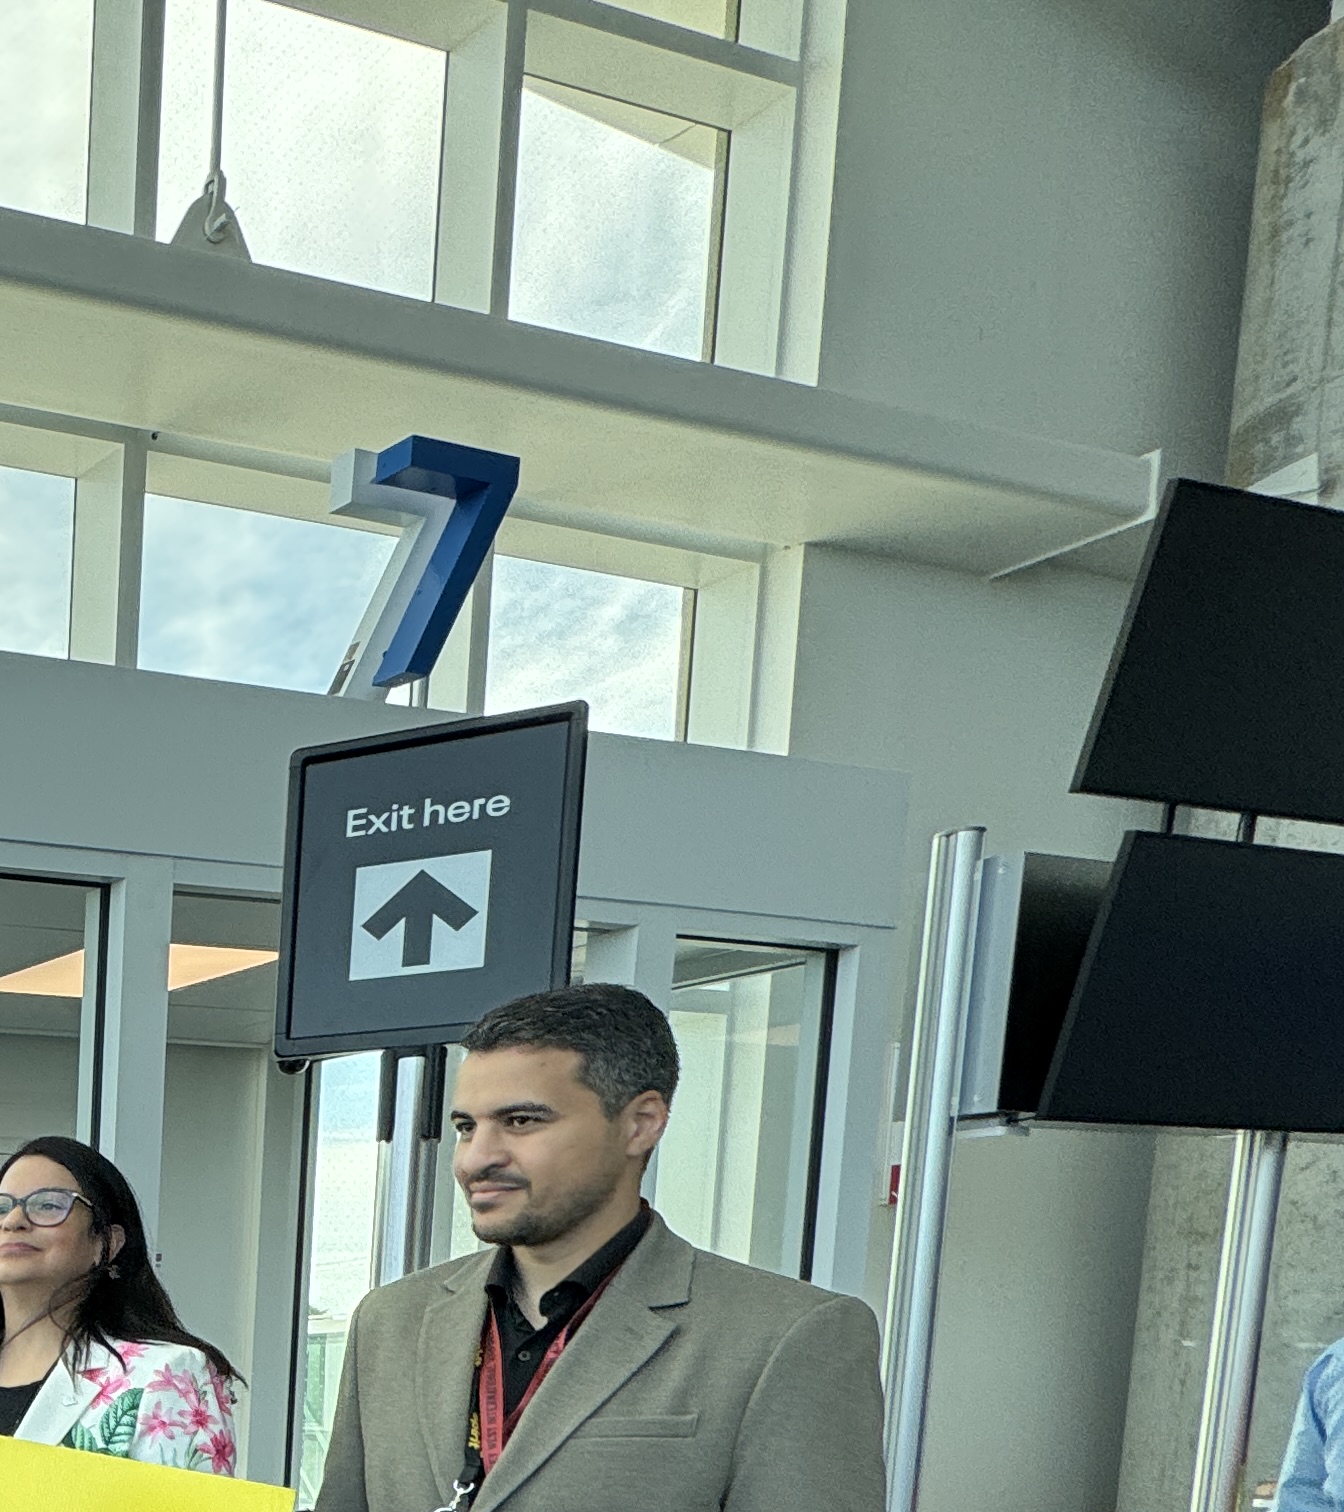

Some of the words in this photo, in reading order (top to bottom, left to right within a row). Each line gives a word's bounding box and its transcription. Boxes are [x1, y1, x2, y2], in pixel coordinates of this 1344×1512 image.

[372, 434, 520, 688] 7
[346, 804, 415, 838] Exit
[423, 794, 511, 828] here
